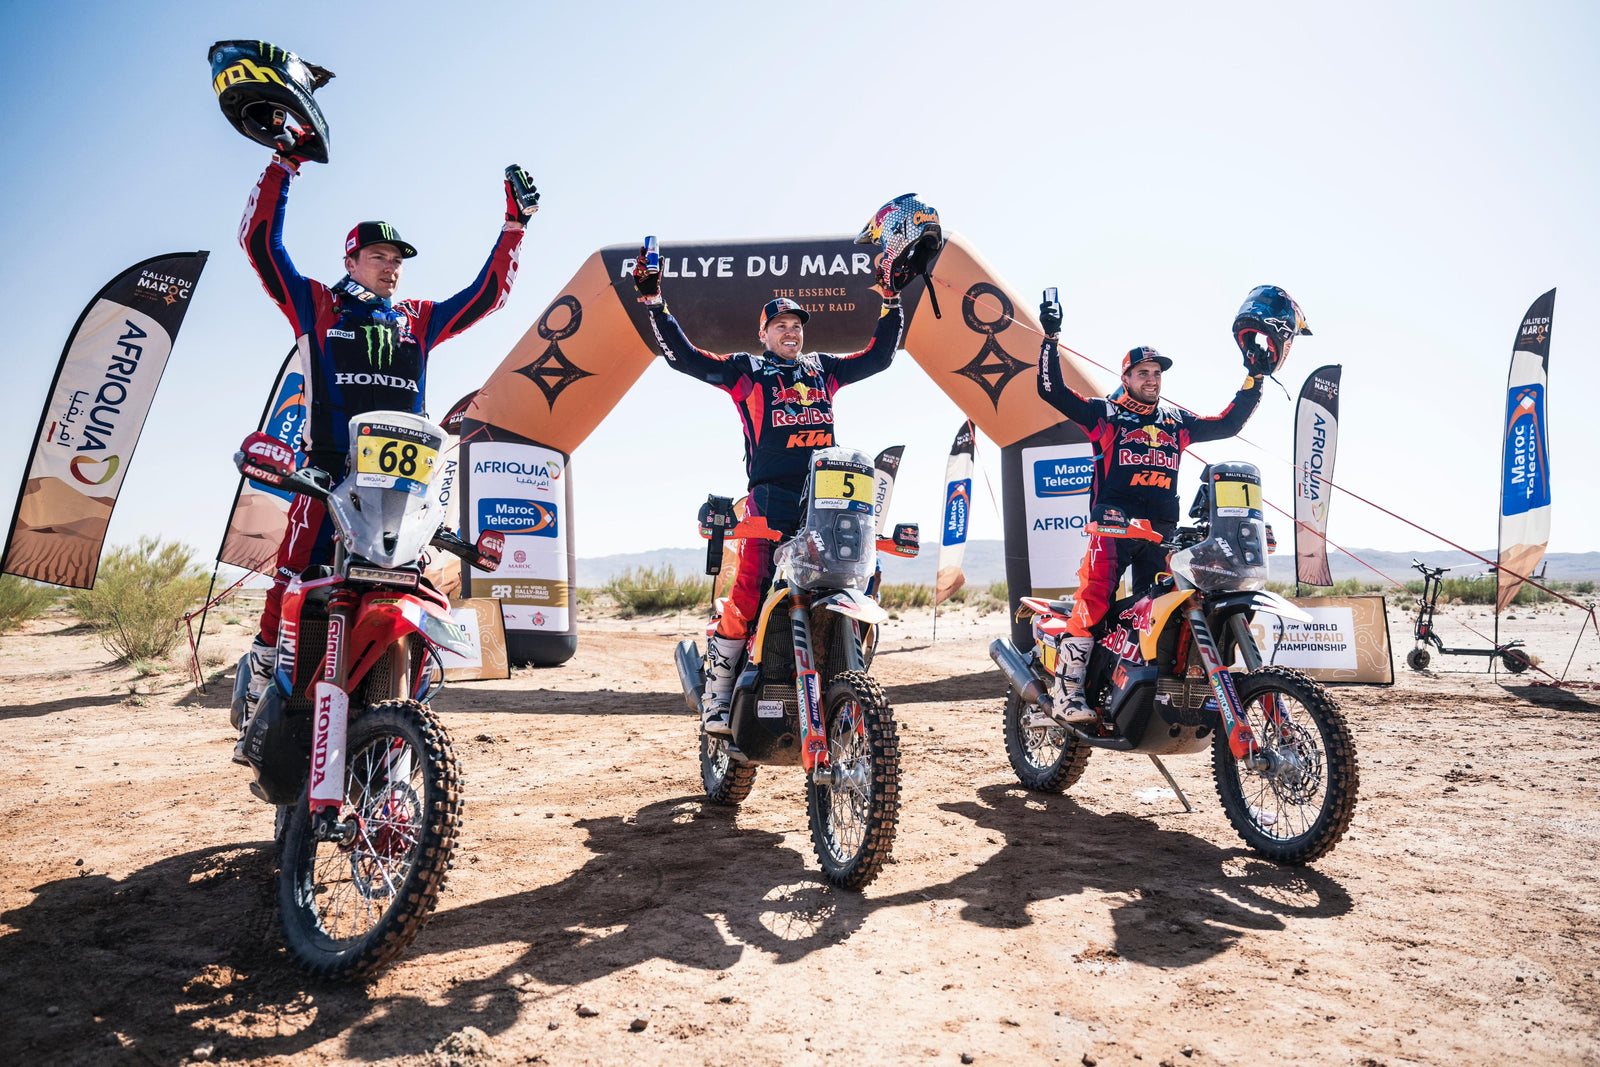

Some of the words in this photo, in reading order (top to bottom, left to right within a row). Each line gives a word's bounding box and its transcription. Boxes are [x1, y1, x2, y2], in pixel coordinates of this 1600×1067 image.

[620, 257, 734, 278] RLLYE
[747, 255, 789, 277] DU
[800, 252, 872, 277] MAR
[137, 277, 189, 299] MAROC
[142, 270, 177, 284] RALLYE
[178, 279, 192, 289] DU
[773, 289, 795, 298] THE
[798, 287, 847, 297] ESSENCE
[800, 303, 826, 313] ALLY
[829, 303, 856, 312] RAID
[328, 330, 354, 339] AIROH
[76, 319, 148, 451] AFRIQUIA
[335, 373, 420, 393] HONDA
[372, 424, 397, 432] RALLYE
[409, 431, 431, 441] MAROC
[786, 430, 833, 449] KTM
[248, 441, 292, 465] GIVI
[379, 441, 418, 477] 68
[1310, 412, 1326, 501] AFRIQUIA
[1512, 424, 1526, 484] Maroc
[245, 465, 279, 483] MOTUL
[474, 461, 549, 478] AFRIQUIA
[1055, 464, 1095, 475] Maroc
[1130, 470, 1172, 490] KTM
[842, 473, 855, 498] 5
[1241, 484, 1250, 506] 1
[495, 504, 534, 515] Maroc
[948, 500, 958, 531] Maroc
[956, 498, 964, 538] Telecom
[485, 515, 535, 526] Telecom
[1273, 632, 1344, 643] RALLY-RAID
[1303, 623, 1338, 631] WORLD
[1274, 643, 1347, 652] CHAMPIONSHIP
[808, 677, 819, 721] MICHELIN
[1223, 673, 1243, 714] MICHELIN
[798, 690, 808, 732] MOTOREX
[1214, 685, 1235, 725] MOTOREX
[311, 694, 332, 790] HONDA
